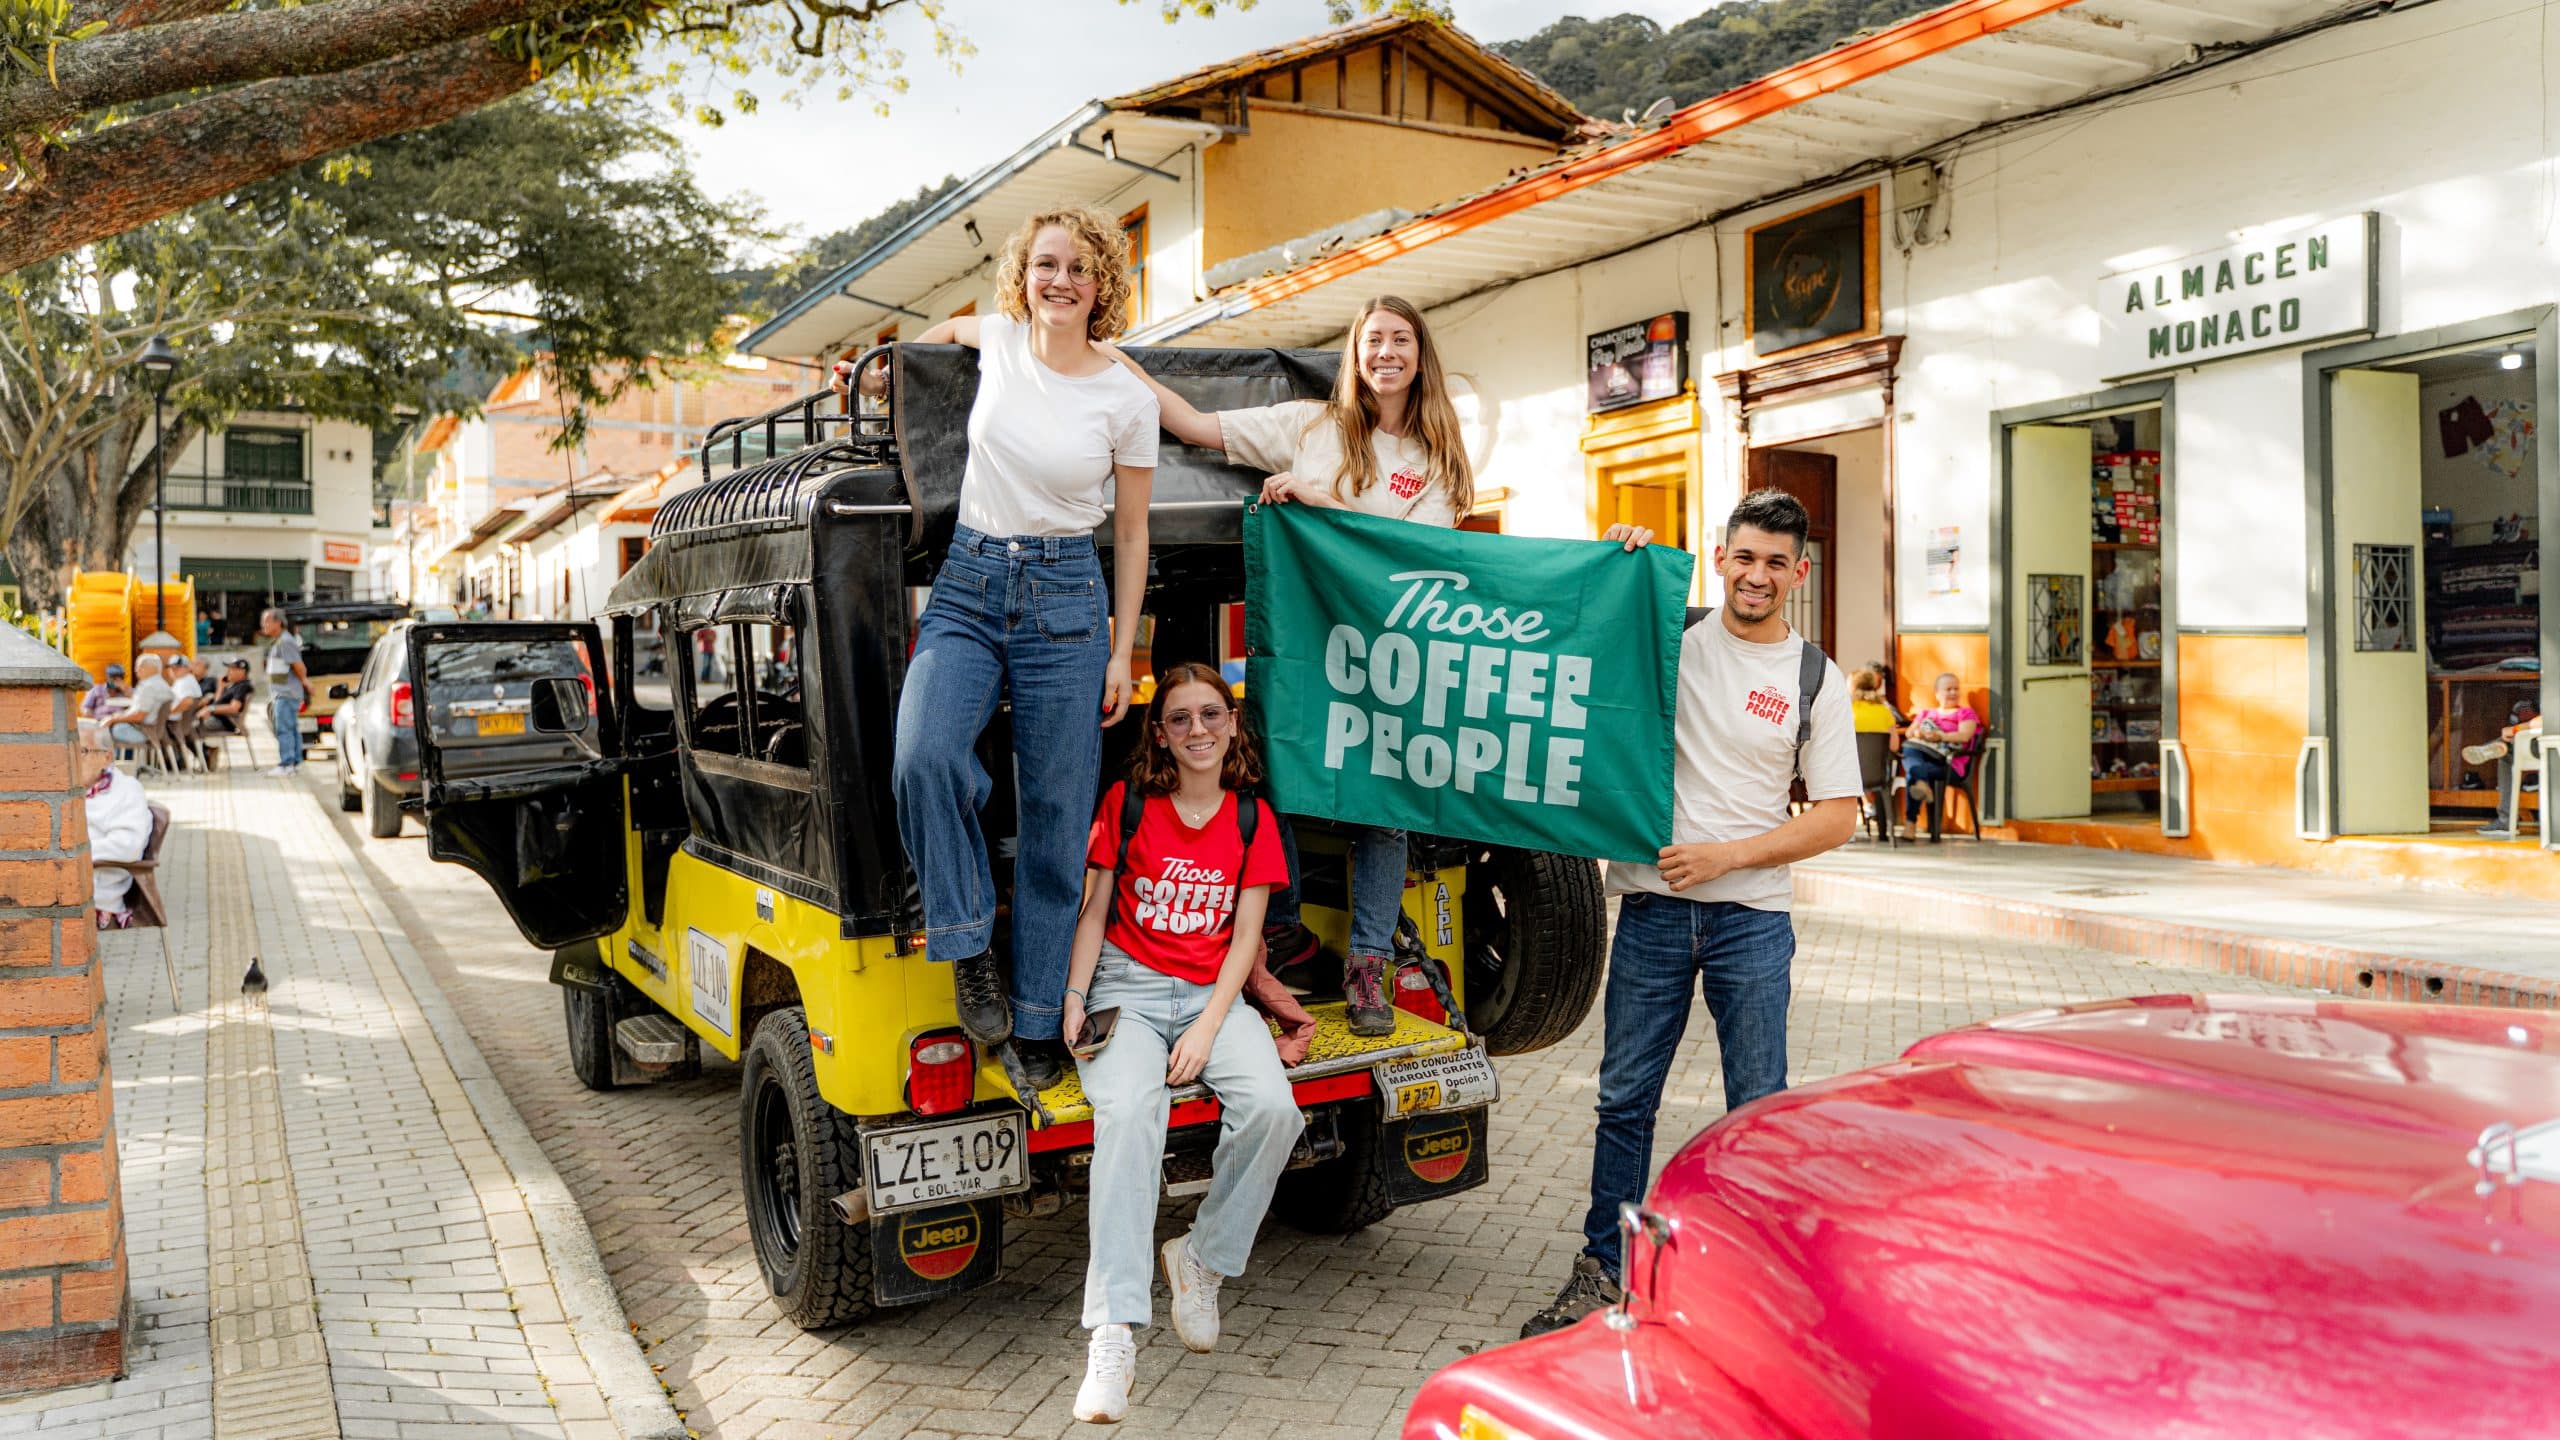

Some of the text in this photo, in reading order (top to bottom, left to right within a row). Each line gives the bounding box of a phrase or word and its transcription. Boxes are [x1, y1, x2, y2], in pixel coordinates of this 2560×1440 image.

[2126, 235, 2328, 313] ALMACEN
[2149, 298, 2300, 358] MONACO
[1389, 483, 1419, 500] PEOP
[1390, 473, 1426, 490] COFFE
[1384, 570, 1550, 642] Those
[1325, 624, 1592, 729] COFFEE
[1745, 702, 1784, 725] PEOPLE
[1748, 690, 1790, 714] COFFEE
[1324, 701, 1584, 807] PEOPLE
[1161, 857, 1225, 883] Those
[1134, 876, 1235, 912] COFFEE
[1434, 883, 1453, 947] ACPM
[1421, 1053, 1473, 1068] CONDUZCO
[1388, 1061, 1485, 1085] MARQUE GRATIS
[1446, 1071, 1488, 1088] Opción 3
[1416, 1135, 1462, 1156] Jeep
[912, 1225, 968, 1249] Jeep
